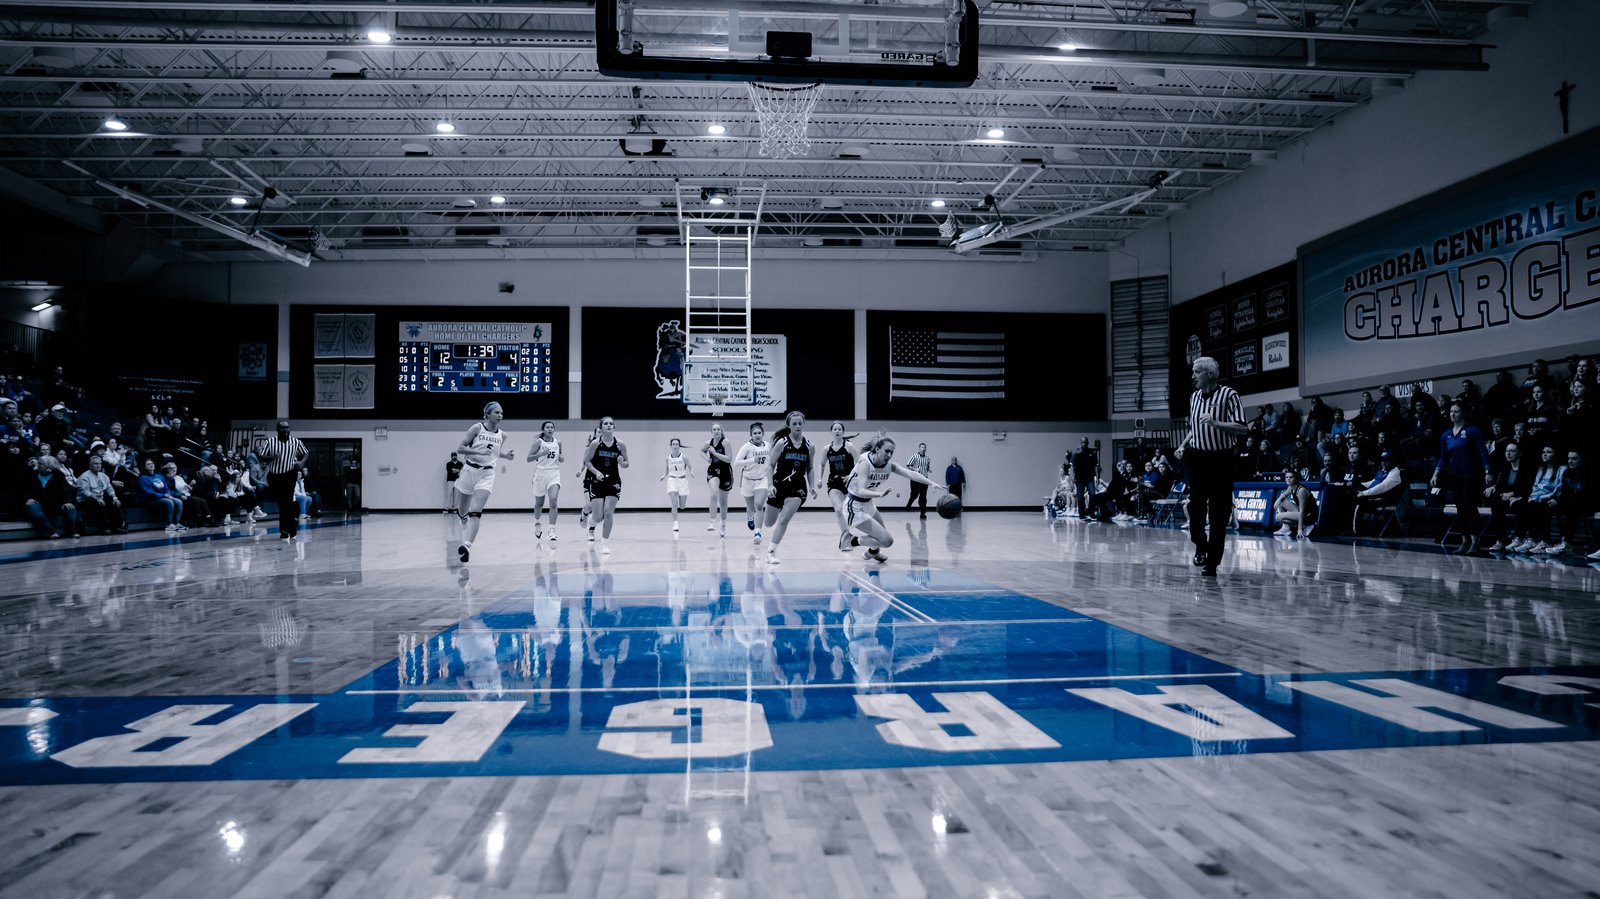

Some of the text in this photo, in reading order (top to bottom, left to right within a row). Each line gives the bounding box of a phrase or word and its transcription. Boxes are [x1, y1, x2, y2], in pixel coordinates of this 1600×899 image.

[1344, 190, 1600, 292] AURORA CENTRAL C
[460, 324, 490, 332] CENTRAL
[468, 346, 494, 357] 1:39
[440, 352, 450, 364] 12
[510, 353, 517, 364] 4
[438, 377, 444, 386] 2
[511, 378, 517, 387] 2
[1398, 382, 1430, 396] VISIRS
